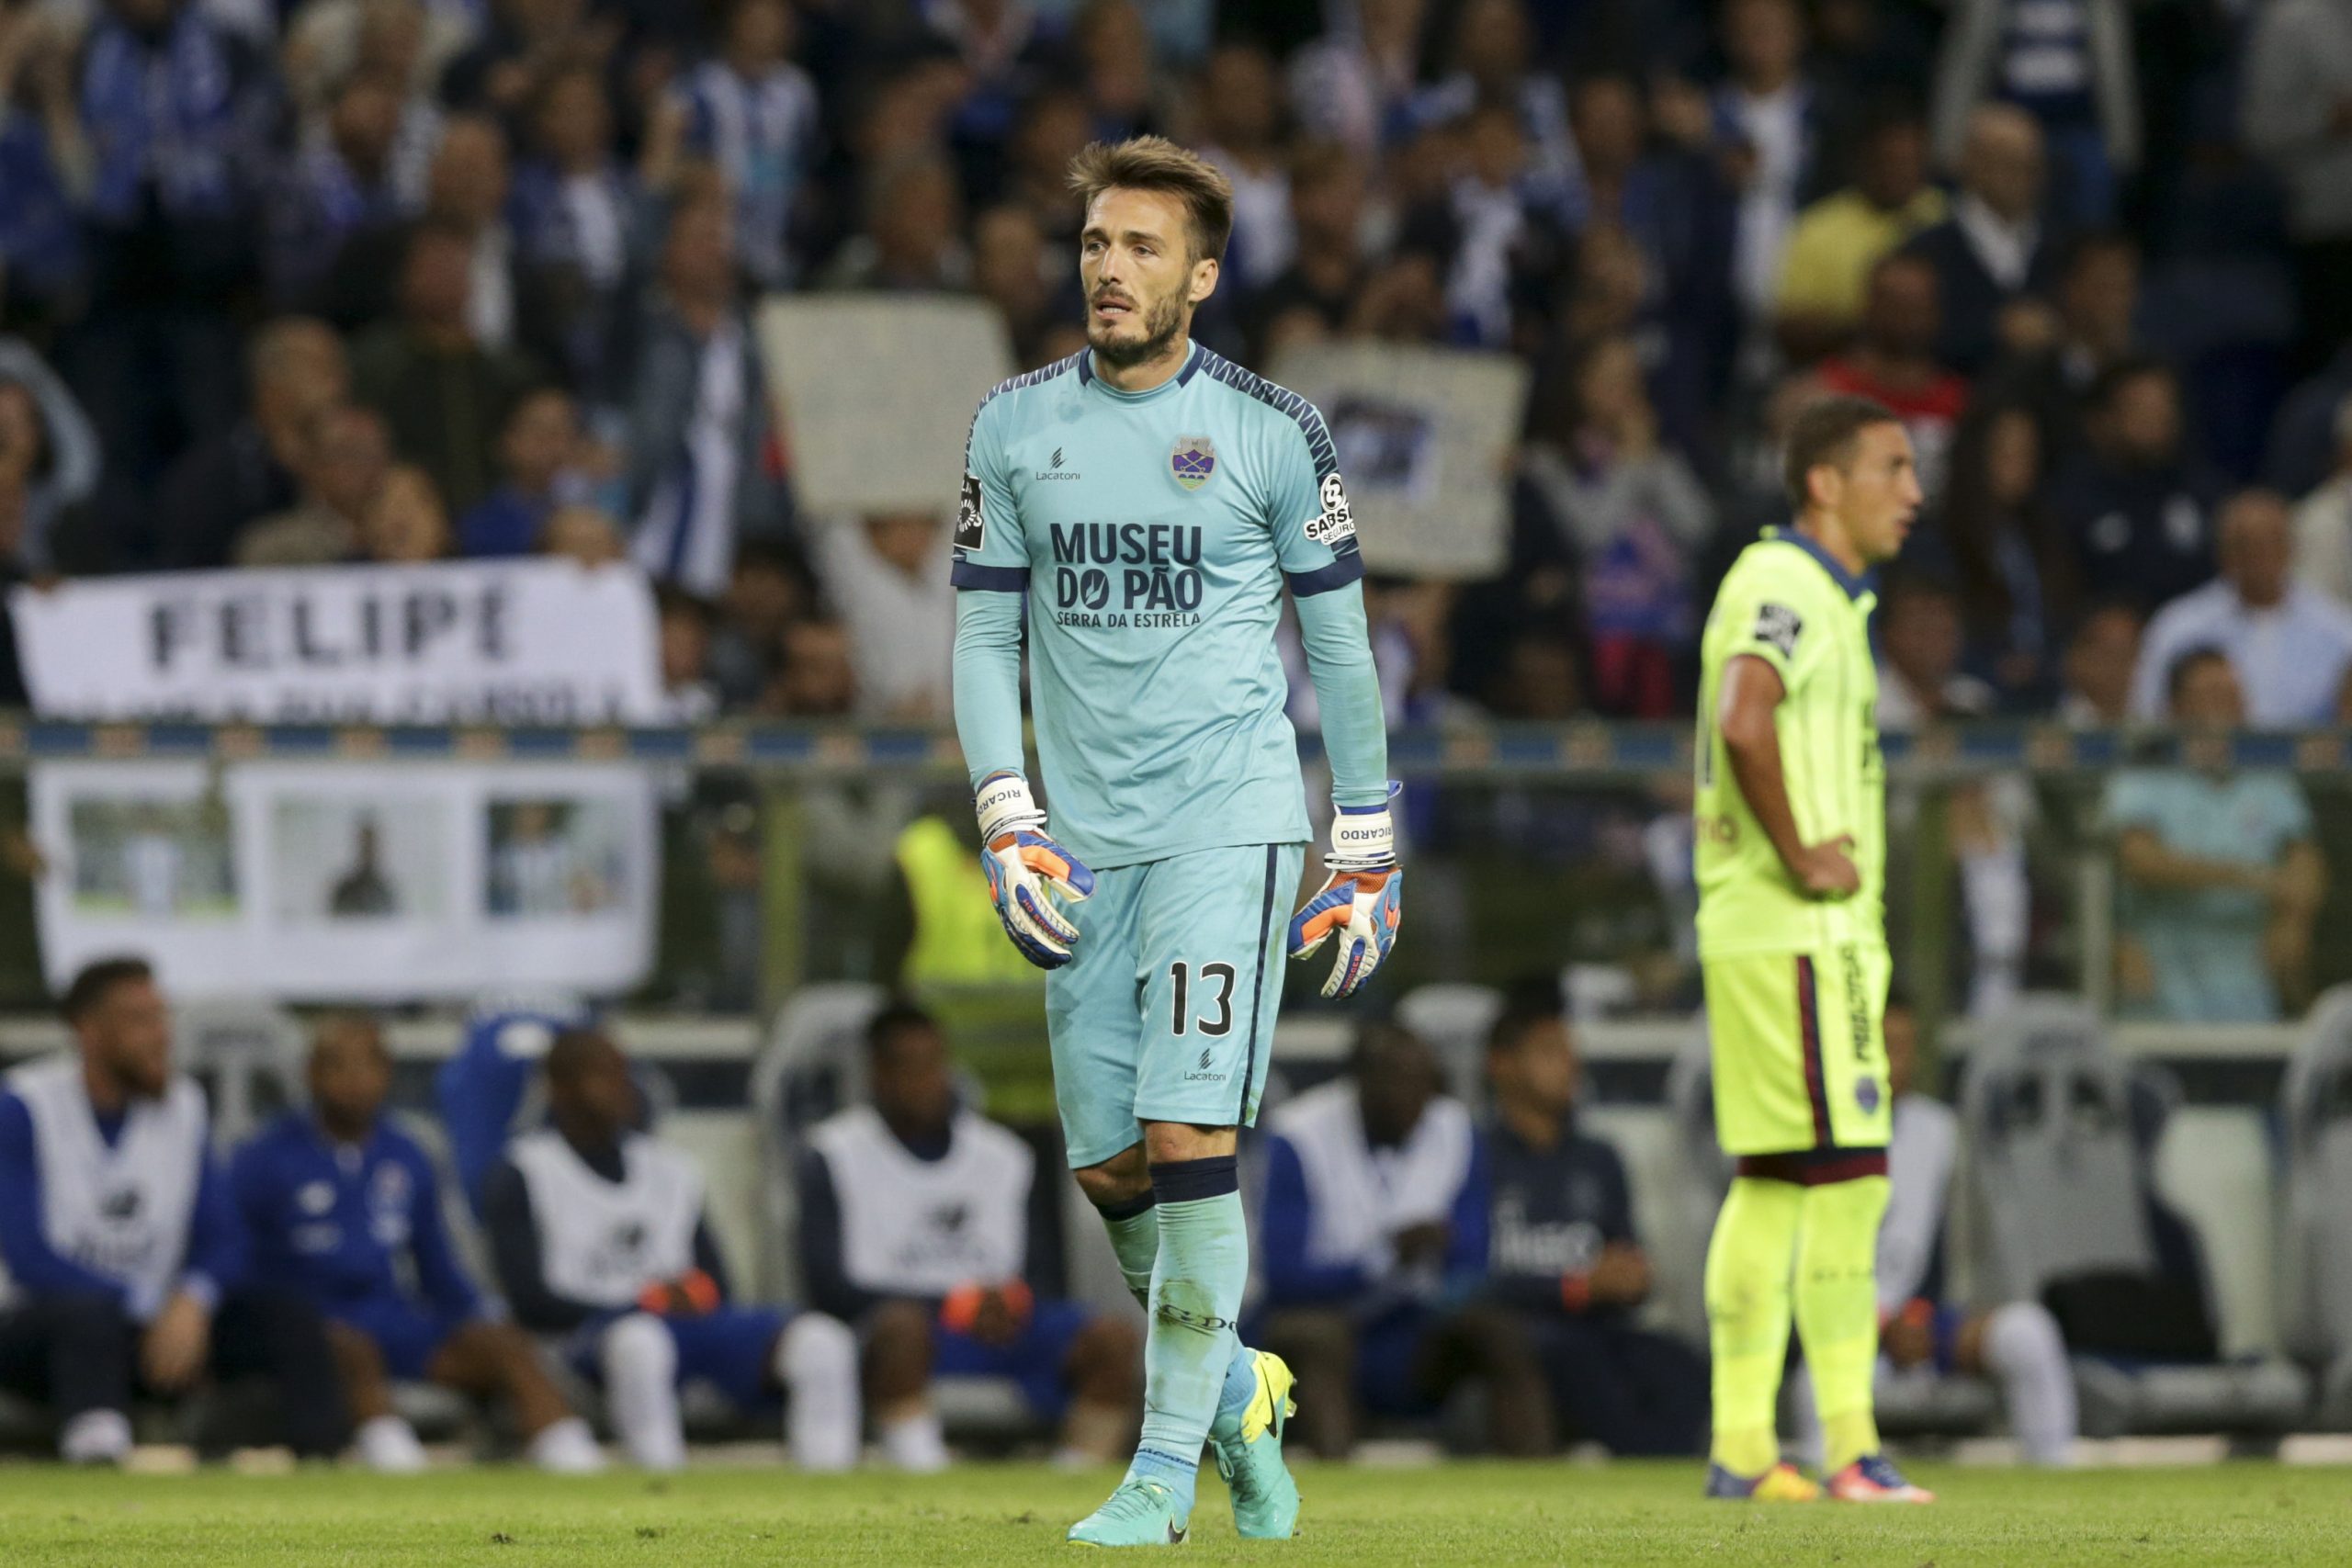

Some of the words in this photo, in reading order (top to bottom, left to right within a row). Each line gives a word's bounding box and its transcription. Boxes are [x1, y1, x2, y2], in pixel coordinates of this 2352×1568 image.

[1035, 470, 1081, 480] Lacatoni
[1050, 523, 1202, 564] MUSEU
[1057, 567, 1110, 610] DO
[1123, 566, 1204, 611] PÃO
[147, 581, 520, 671] FELIPE
[1056, 610, 1102, 628] SERRA
[1107, 612, 1128, 628] DA
[1134, 613, 1201, 628] ESTRELA
[1340, 826, 1393, 840] RICARDO
[1170, 962, 1236, 1036] 13
[1183, 1070, 1227, 1082] Lacatoni
